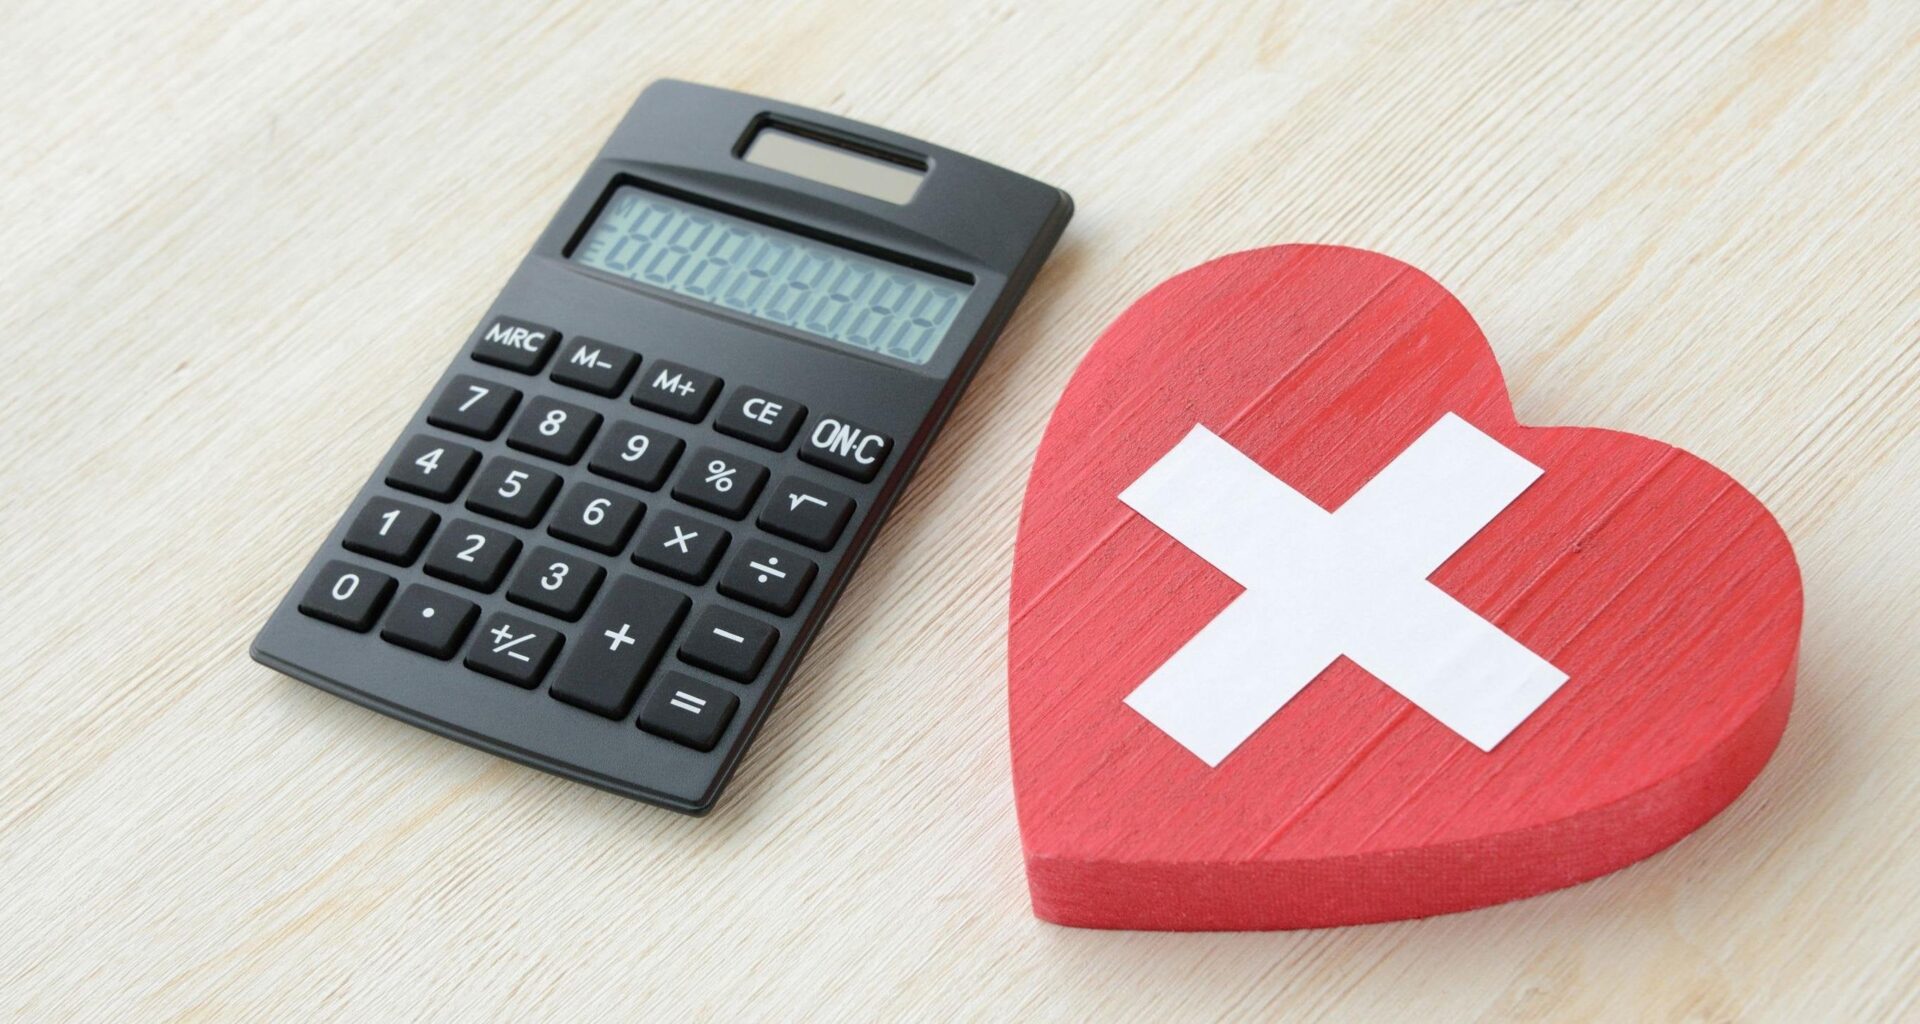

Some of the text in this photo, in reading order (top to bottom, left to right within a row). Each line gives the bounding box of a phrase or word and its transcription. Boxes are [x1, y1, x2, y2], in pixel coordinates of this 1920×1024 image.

[485, 323, 546, 352] MRC
[570, 345, 612, 369] M-
[653, 369, 695, 396] M+
[458, 385, 489, 412] 7
[743, 398, 782, 424] CE
[539, 410, 567, 436] 8
[415, 448, 445, 475] 4
[621, 435, 649, 461] 9
[498, 470, 529, 497] 5
[705, 460, 736, 492] %
[379, 510, 400, 535] 1
[583, 498, 611, 525] 6
[457, 534, 485, 562] 2
[332, 574, 359, 600] 0
[541, 563, 569, 590] 3
[605, 624, 635, 651] +
[671, 691, 706, 714] =
